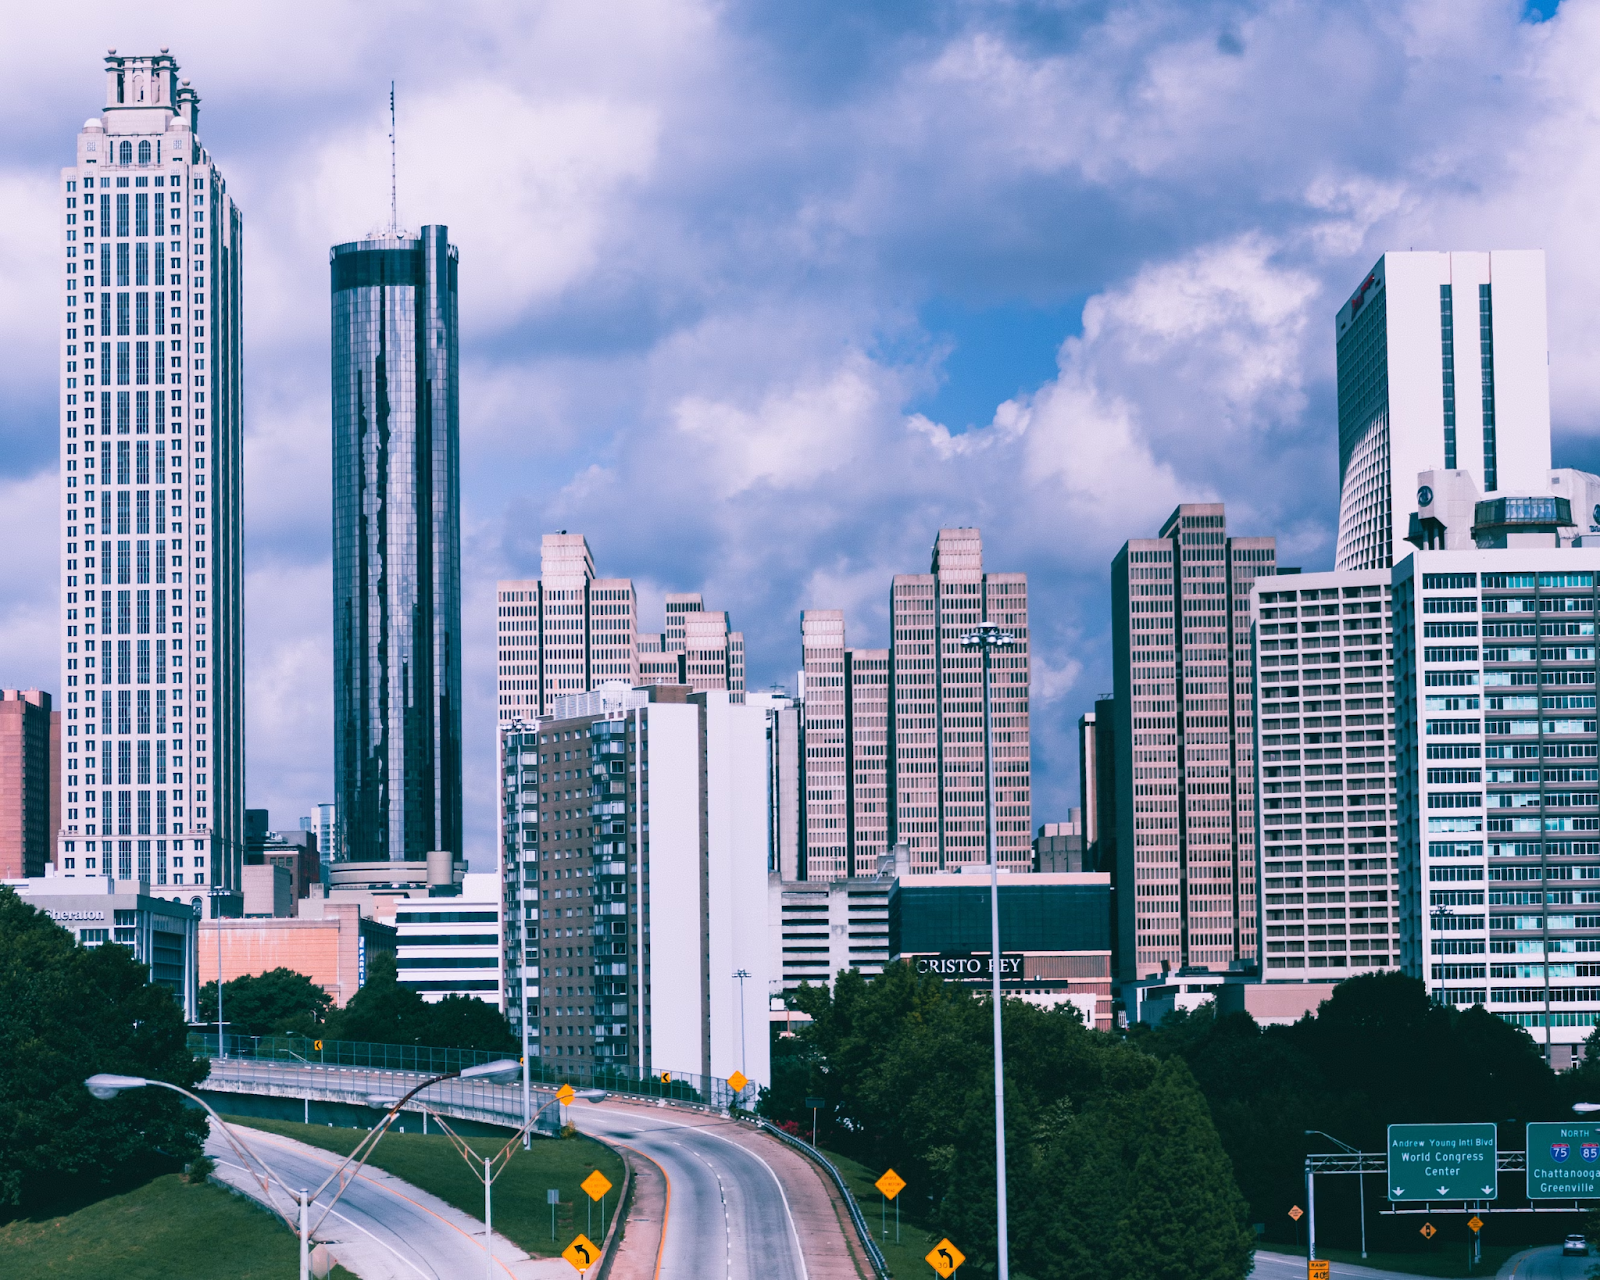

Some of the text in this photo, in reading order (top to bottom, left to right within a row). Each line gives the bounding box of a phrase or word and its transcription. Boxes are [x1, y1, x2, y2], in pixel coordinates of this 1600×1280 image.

[916, 958, 981, 973] CRISTO
[1560, 1128, 1590, 1138] NORTH
[1392, 1138, 1494, 1149] Andrew Young Intl Blvd
[1401, 1151, 1484, 1164] World Congress
[1553, 1147, 1568, 1158] 75
[1582, 1147, 1598, 1159] 85
[1425, 1166, 1461, 1176] Center
[1533, 1168, 1600, 1181] Chattanooga
[1540, 1182, 1594, 1193] Greenville
[1313, 1270, 1326, 1280] 40
